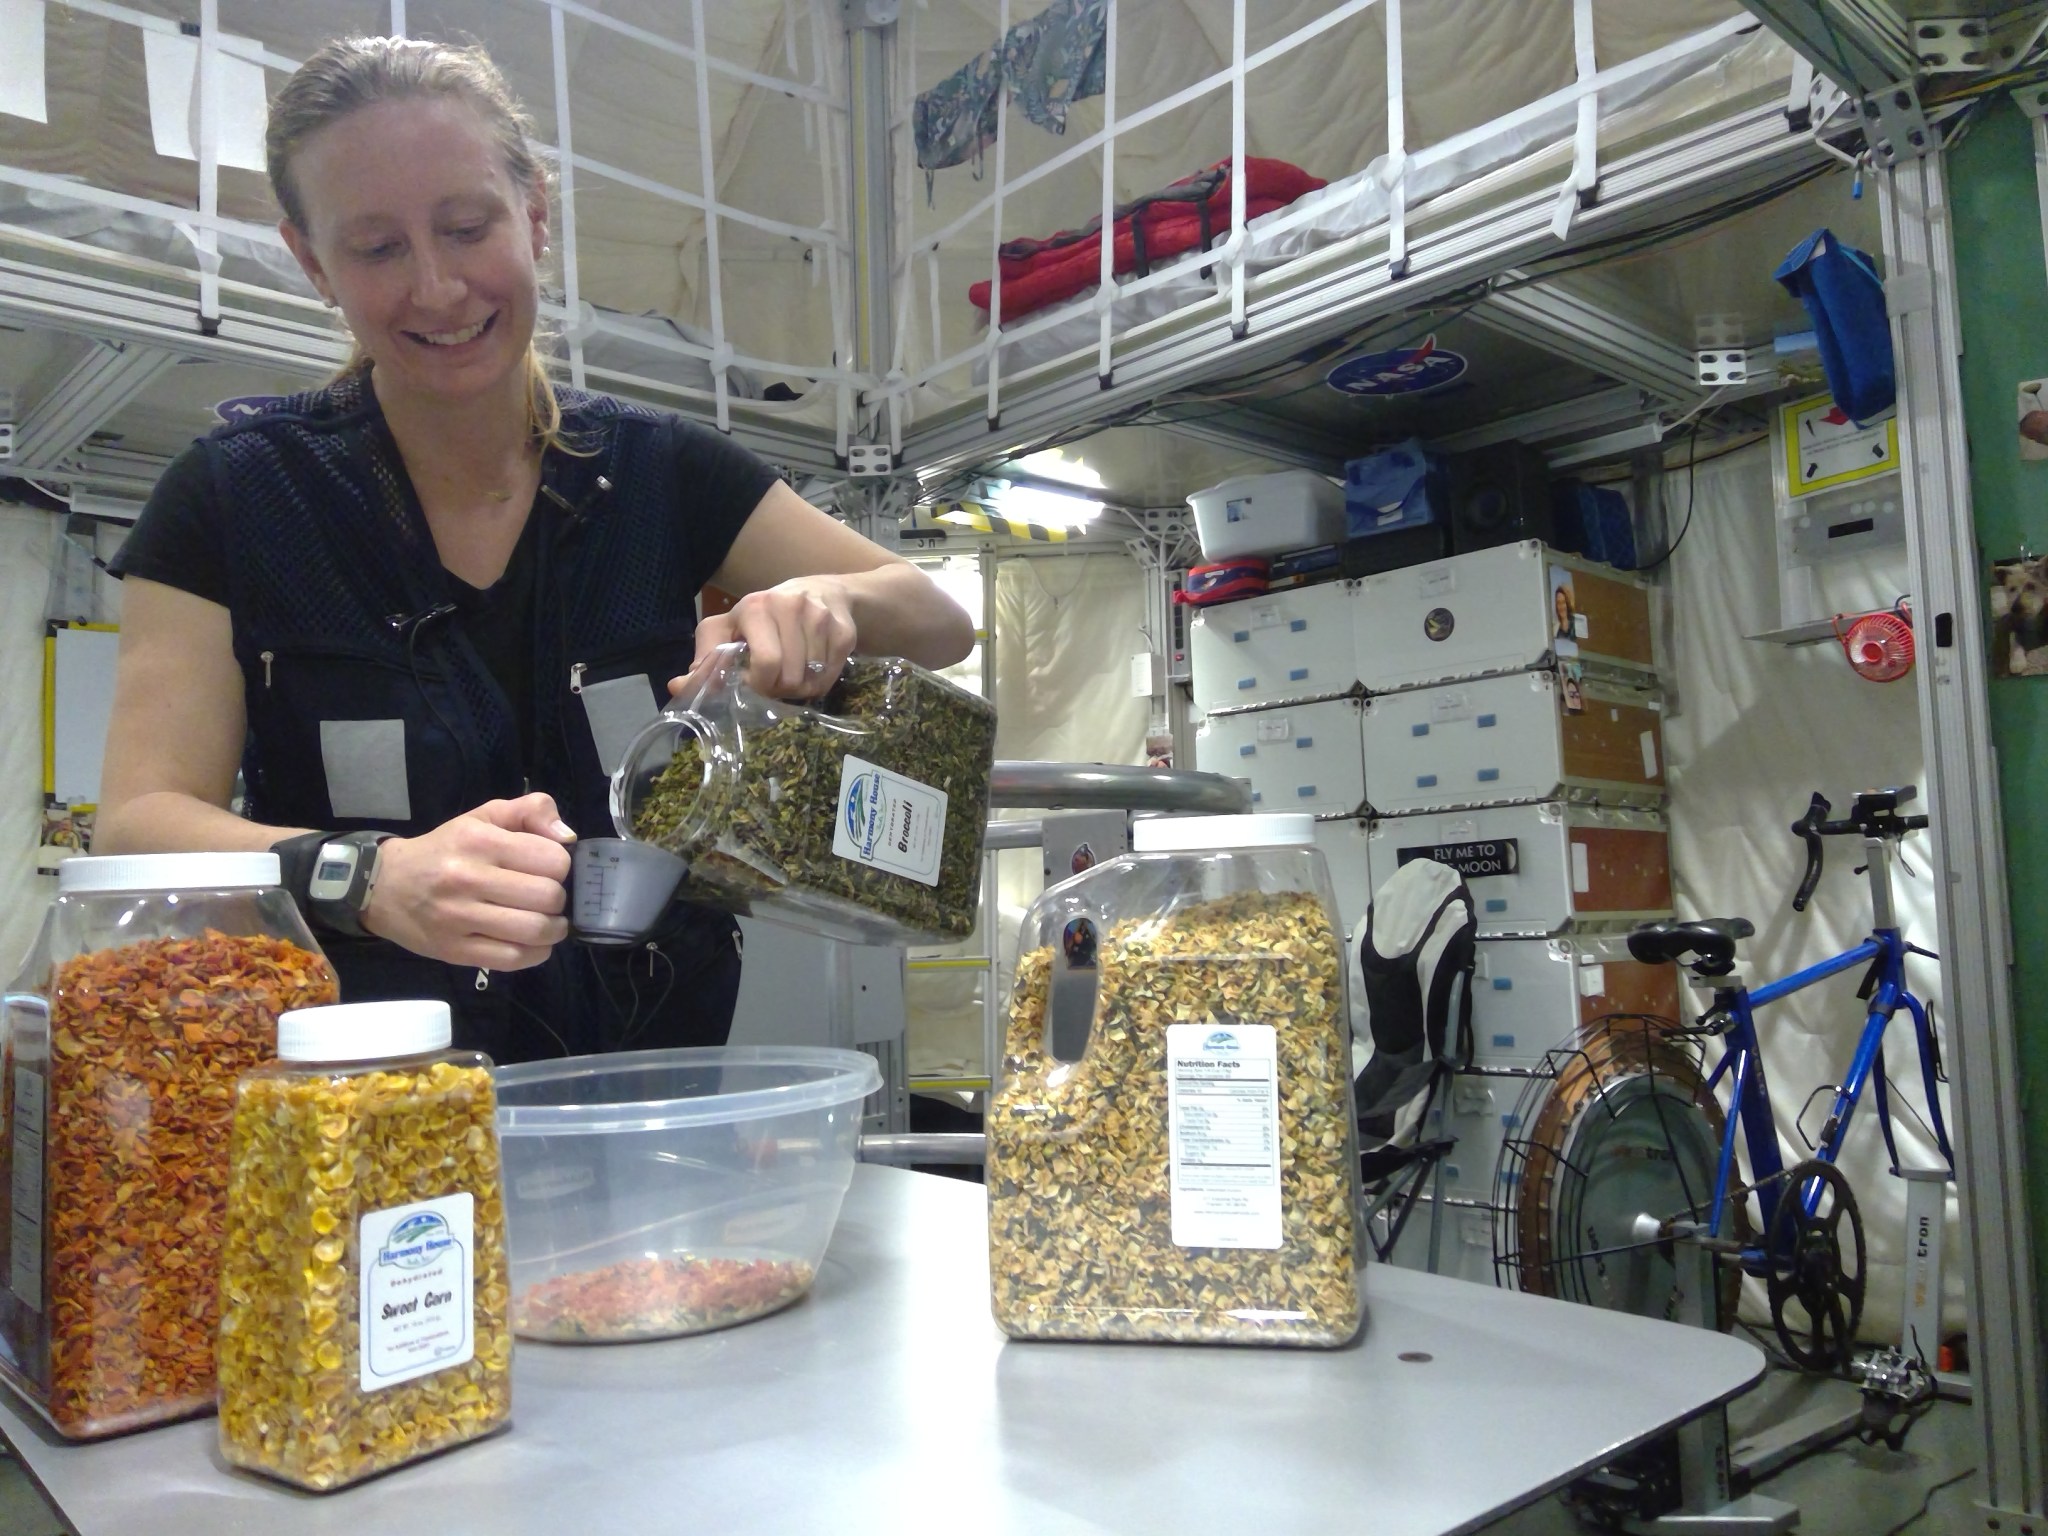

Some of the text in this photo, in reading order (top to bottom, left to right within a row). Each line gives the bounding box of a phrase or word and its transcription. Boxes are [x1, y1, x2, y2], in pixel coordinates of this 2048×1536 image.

[1346, 356, 1453, 390] NASA
[863, 774, 880, 856] Harmony House
[898, 800, 913, 853] Broccoli
[1434, 844, 1496, 860] FLY ME TO
[1458, 860, 1501, 873] MOON
[1177, 1060, 1241, 1069] Nutrition Facts
[381, 1291, 452, 1320] Sweet Corn
